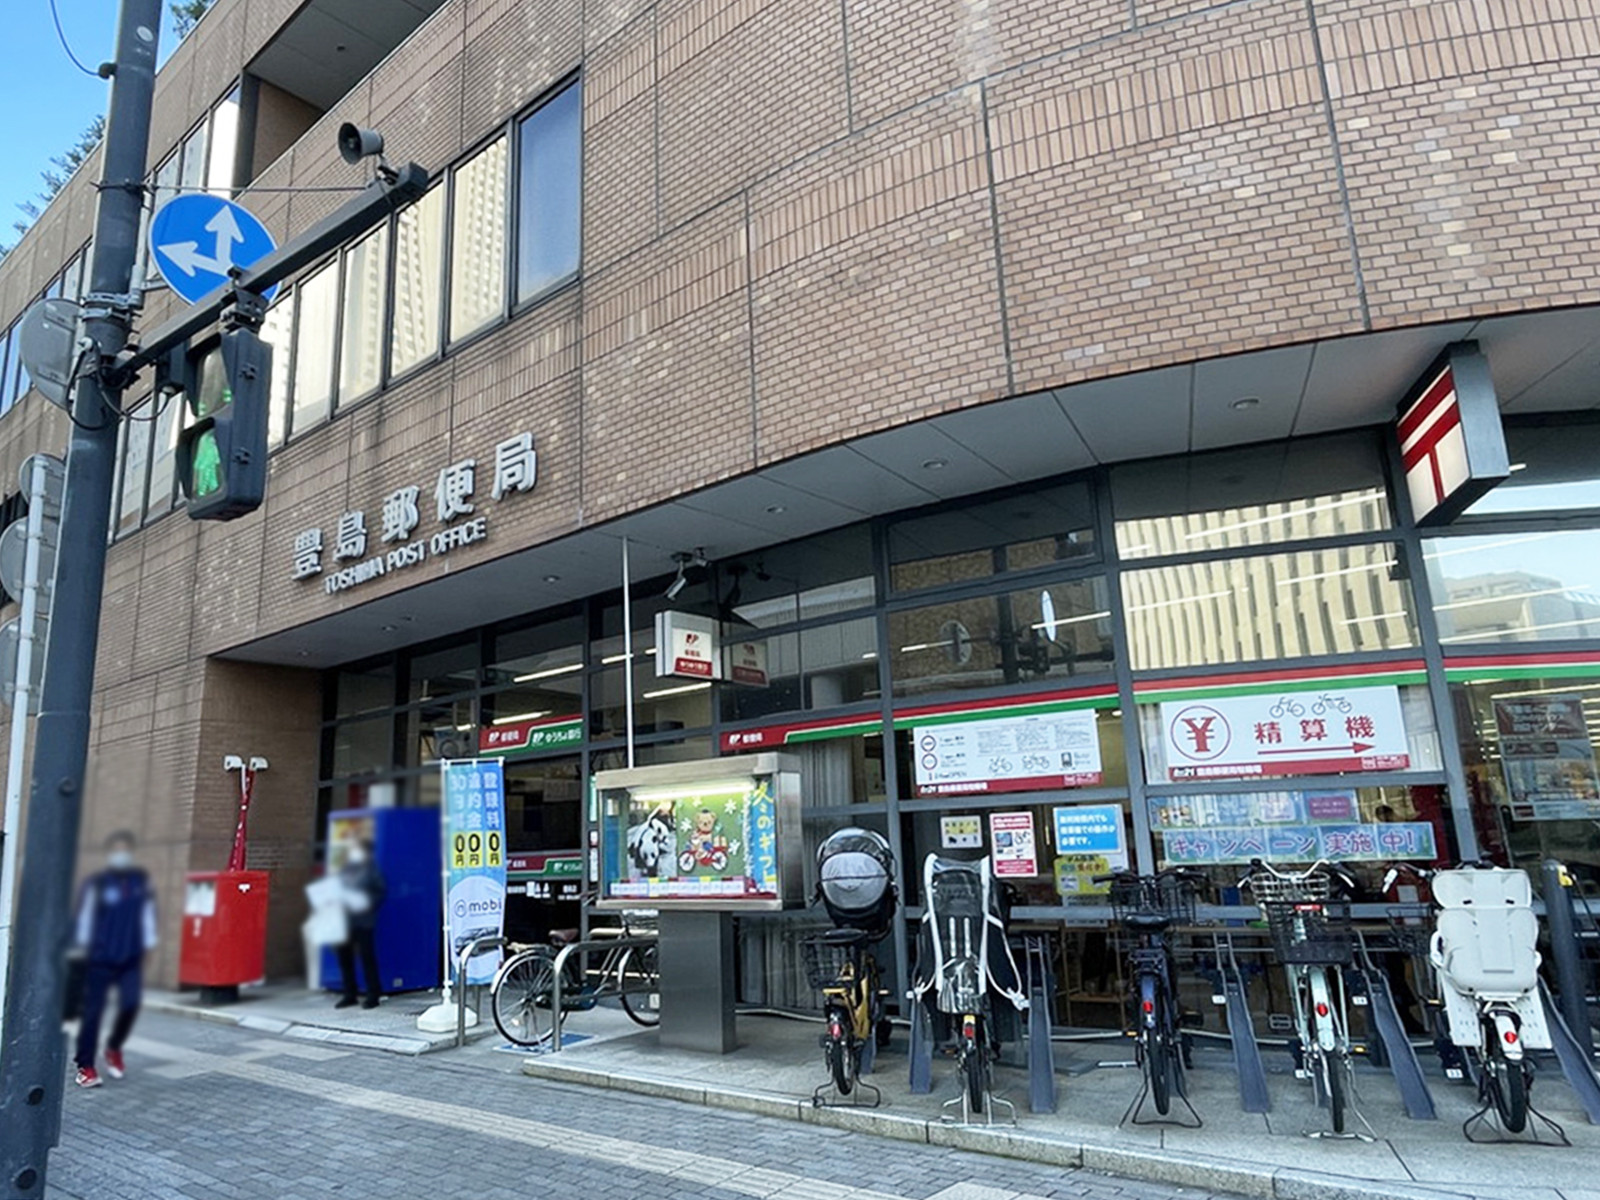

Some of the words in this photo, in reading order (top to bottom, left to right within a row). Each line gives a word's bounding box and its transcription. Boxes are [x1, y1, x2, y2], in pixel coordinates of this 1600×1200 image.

[324, 556, 385, 594] TOSHIMA
[386, 539, 426, 572] POST
[430, 516, 487, 556] OFFICE
[1253, 715, 1376, 744] 精算機
[469, 898, 502, 912] mobi
